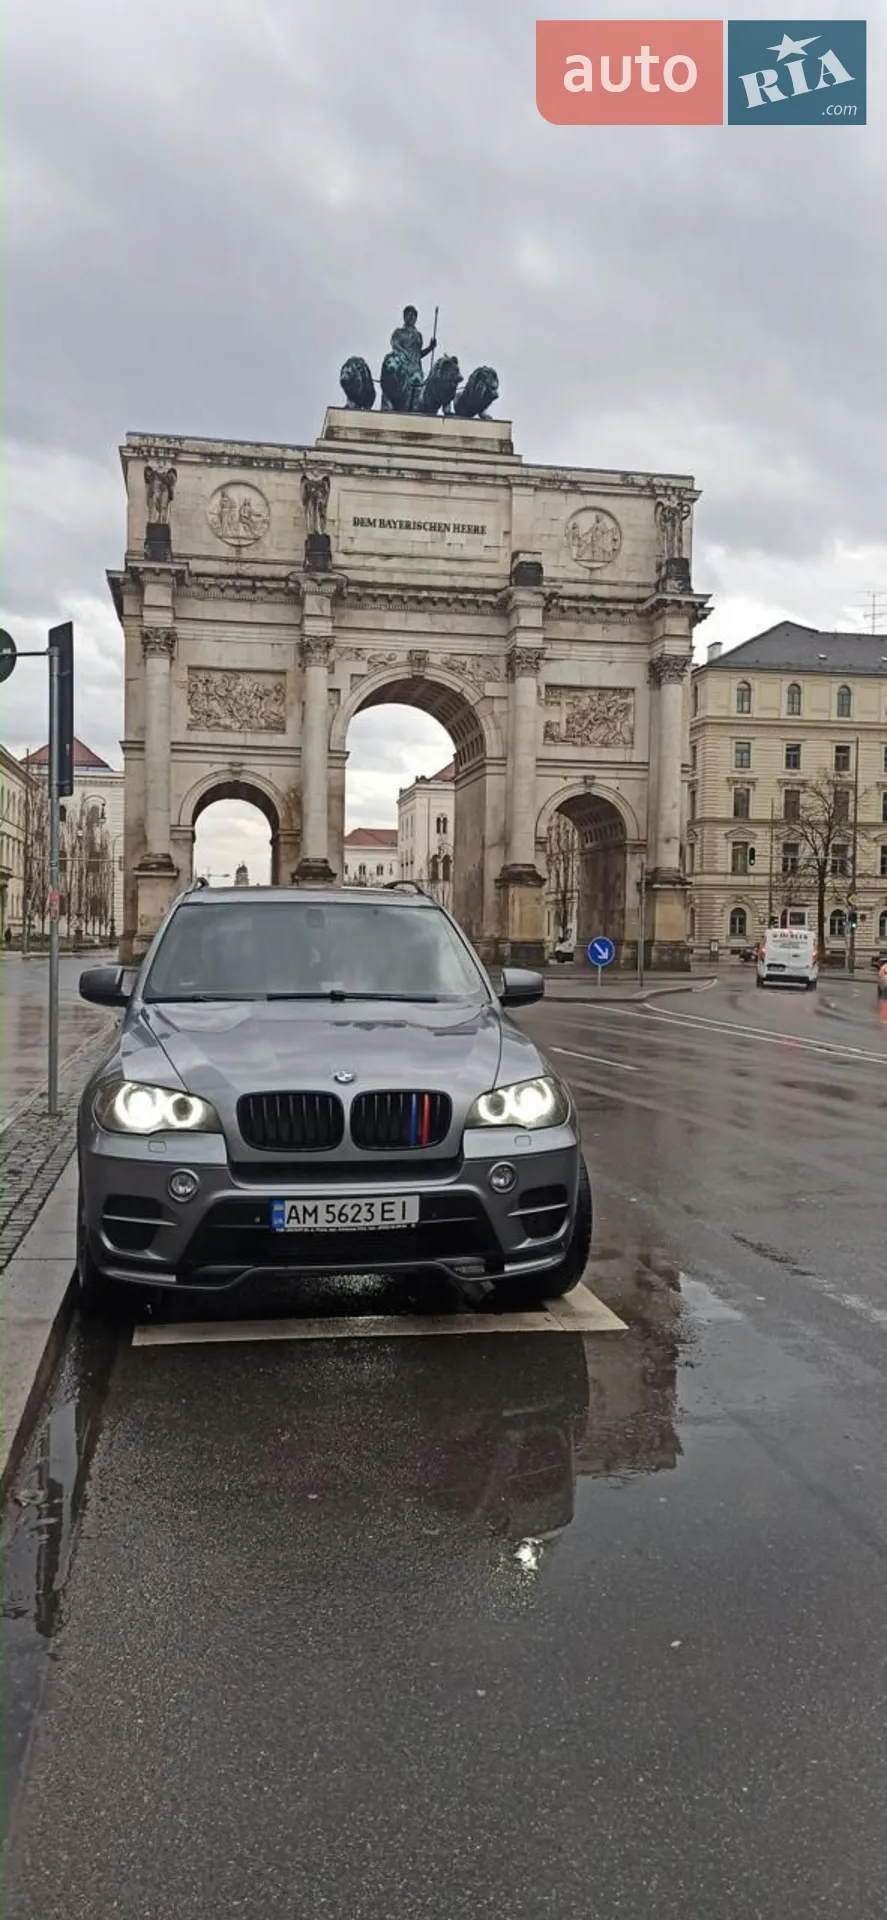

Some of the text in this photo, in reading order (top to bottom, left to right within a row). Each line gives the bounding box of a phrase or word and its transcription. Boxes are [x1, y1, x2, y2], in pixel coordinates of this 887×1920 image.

[353, 516, 487, 535] DEM BAYERISCHEN HEERE
[286, 1201, 406, 1225] AM 5623 EI
